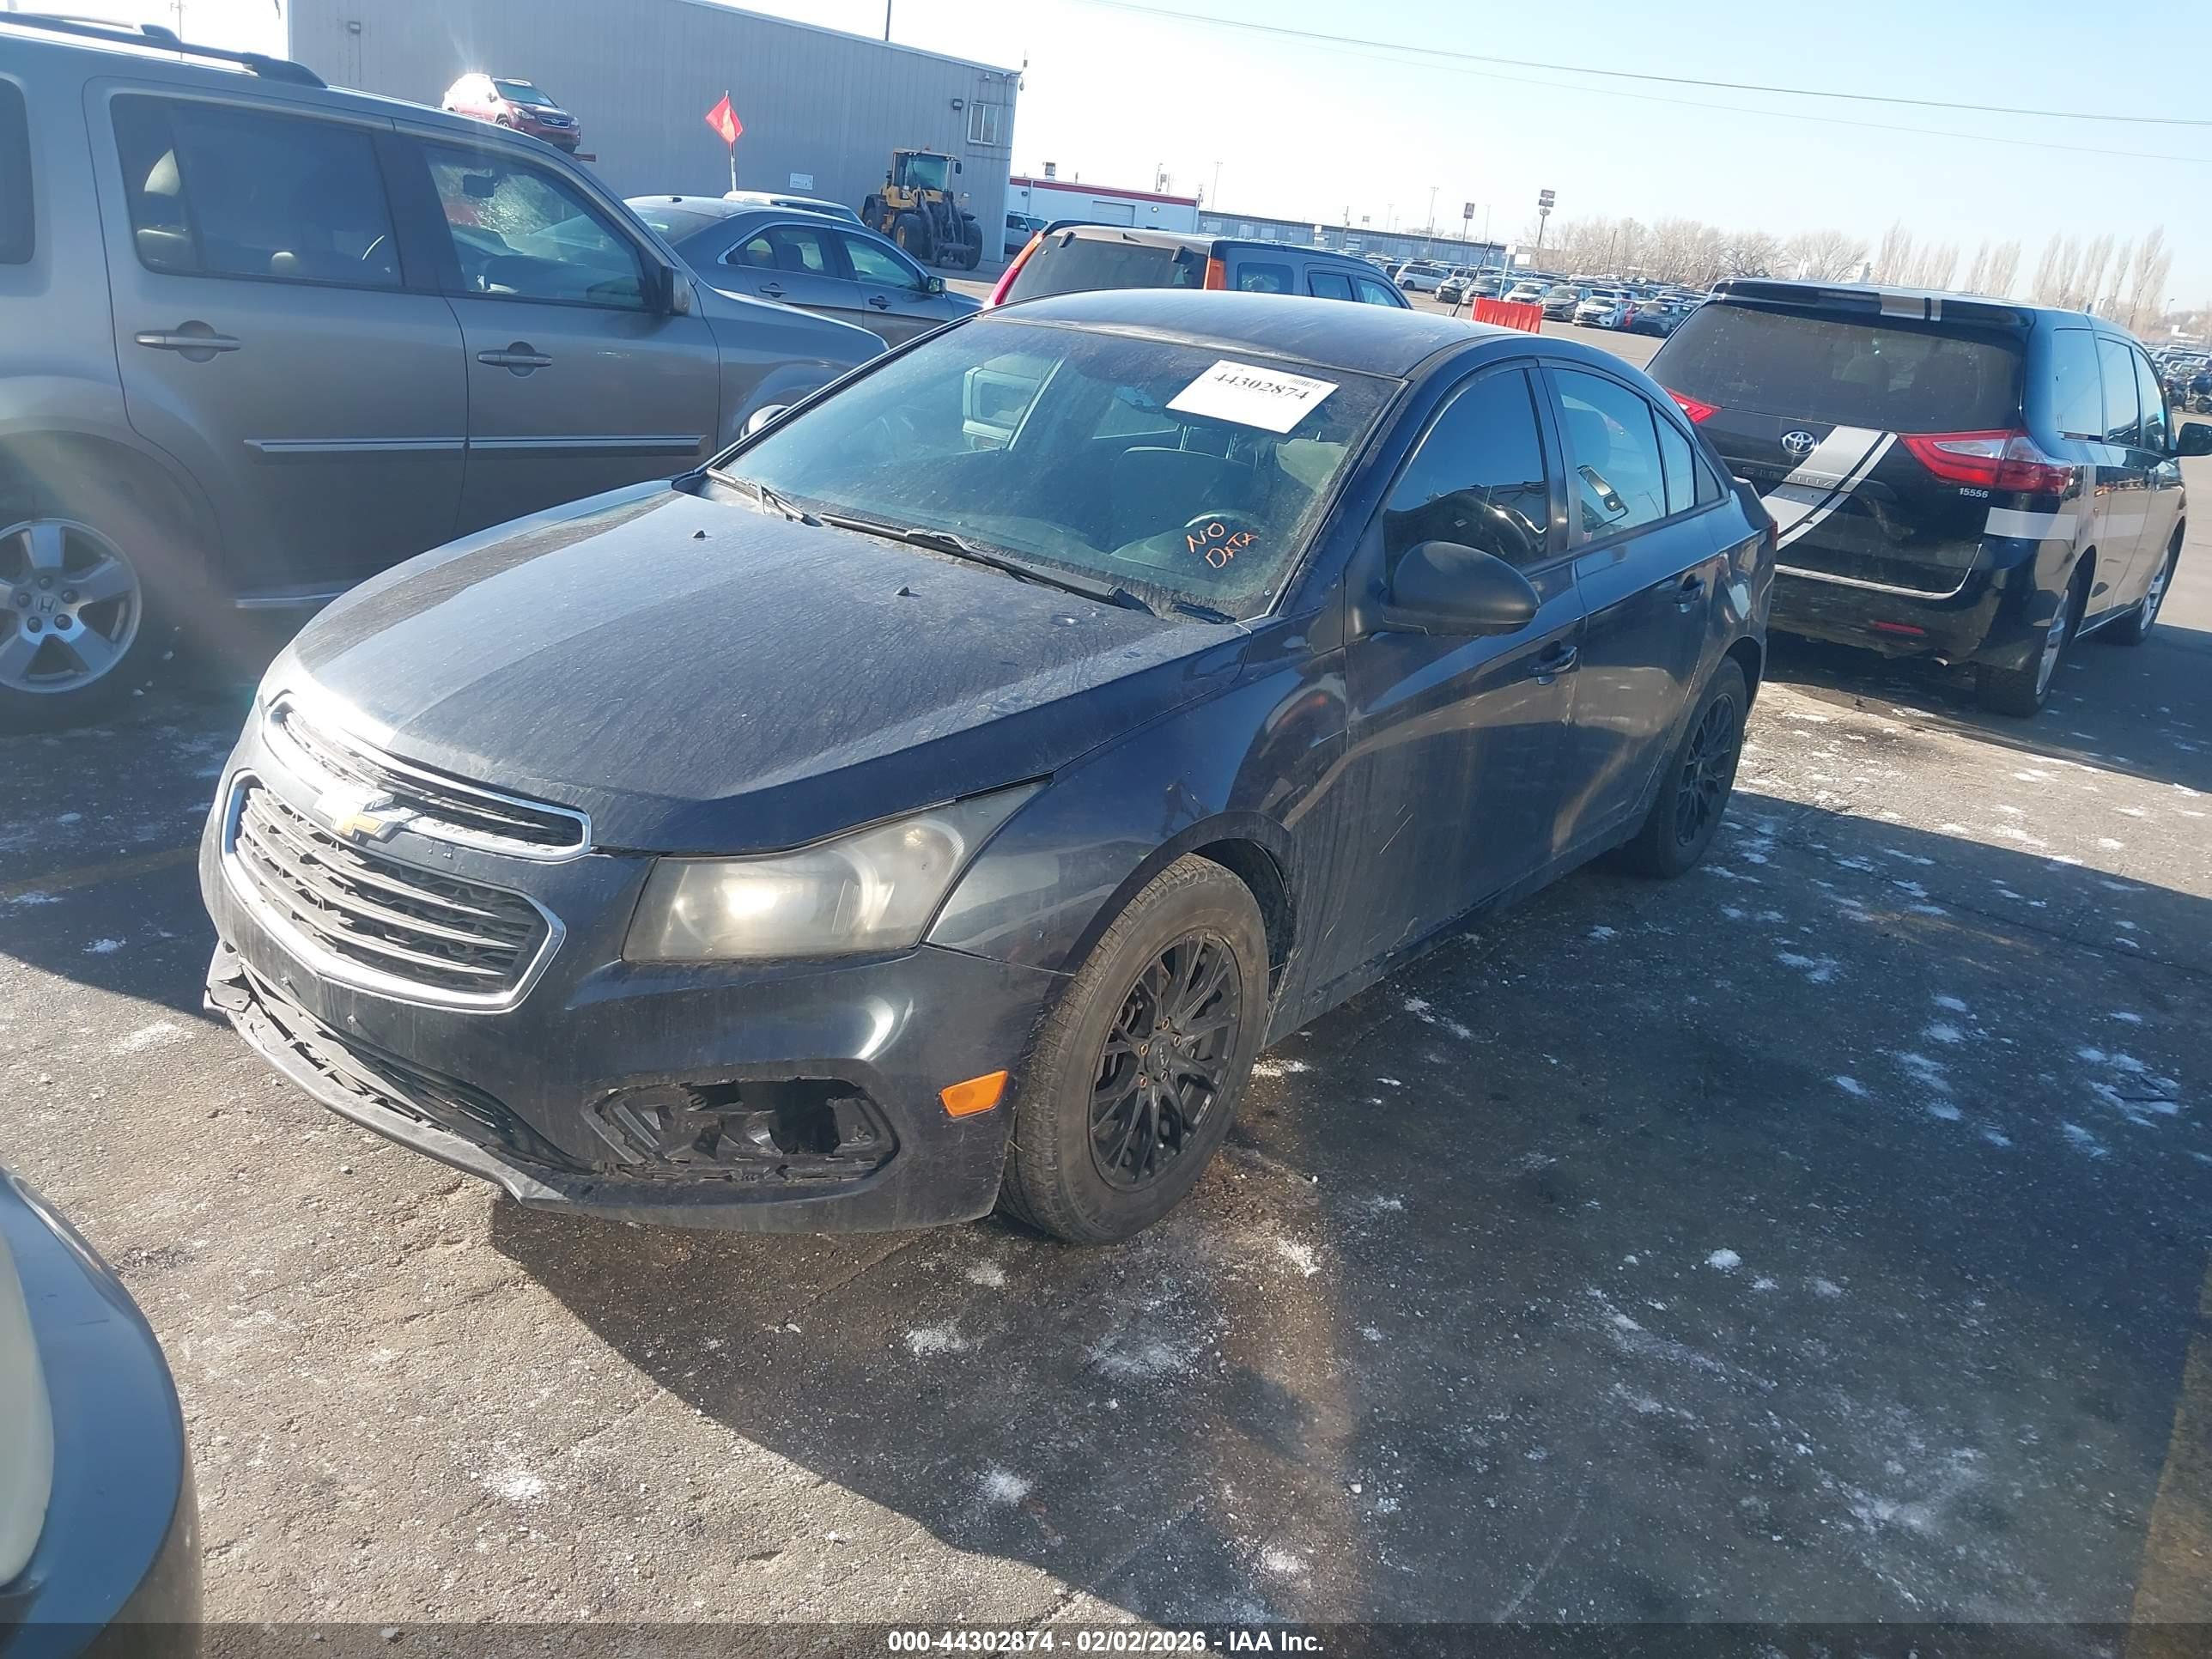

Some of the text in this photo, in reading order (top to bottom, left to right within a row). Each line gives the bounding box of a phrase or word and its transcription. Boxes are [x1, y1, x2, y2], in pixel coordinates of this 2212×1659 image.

[1214, 373, 1310, 400] 44302874
[1959, 487, 1989, 498] 15556
[1187, 522, 1224, 553] NO
